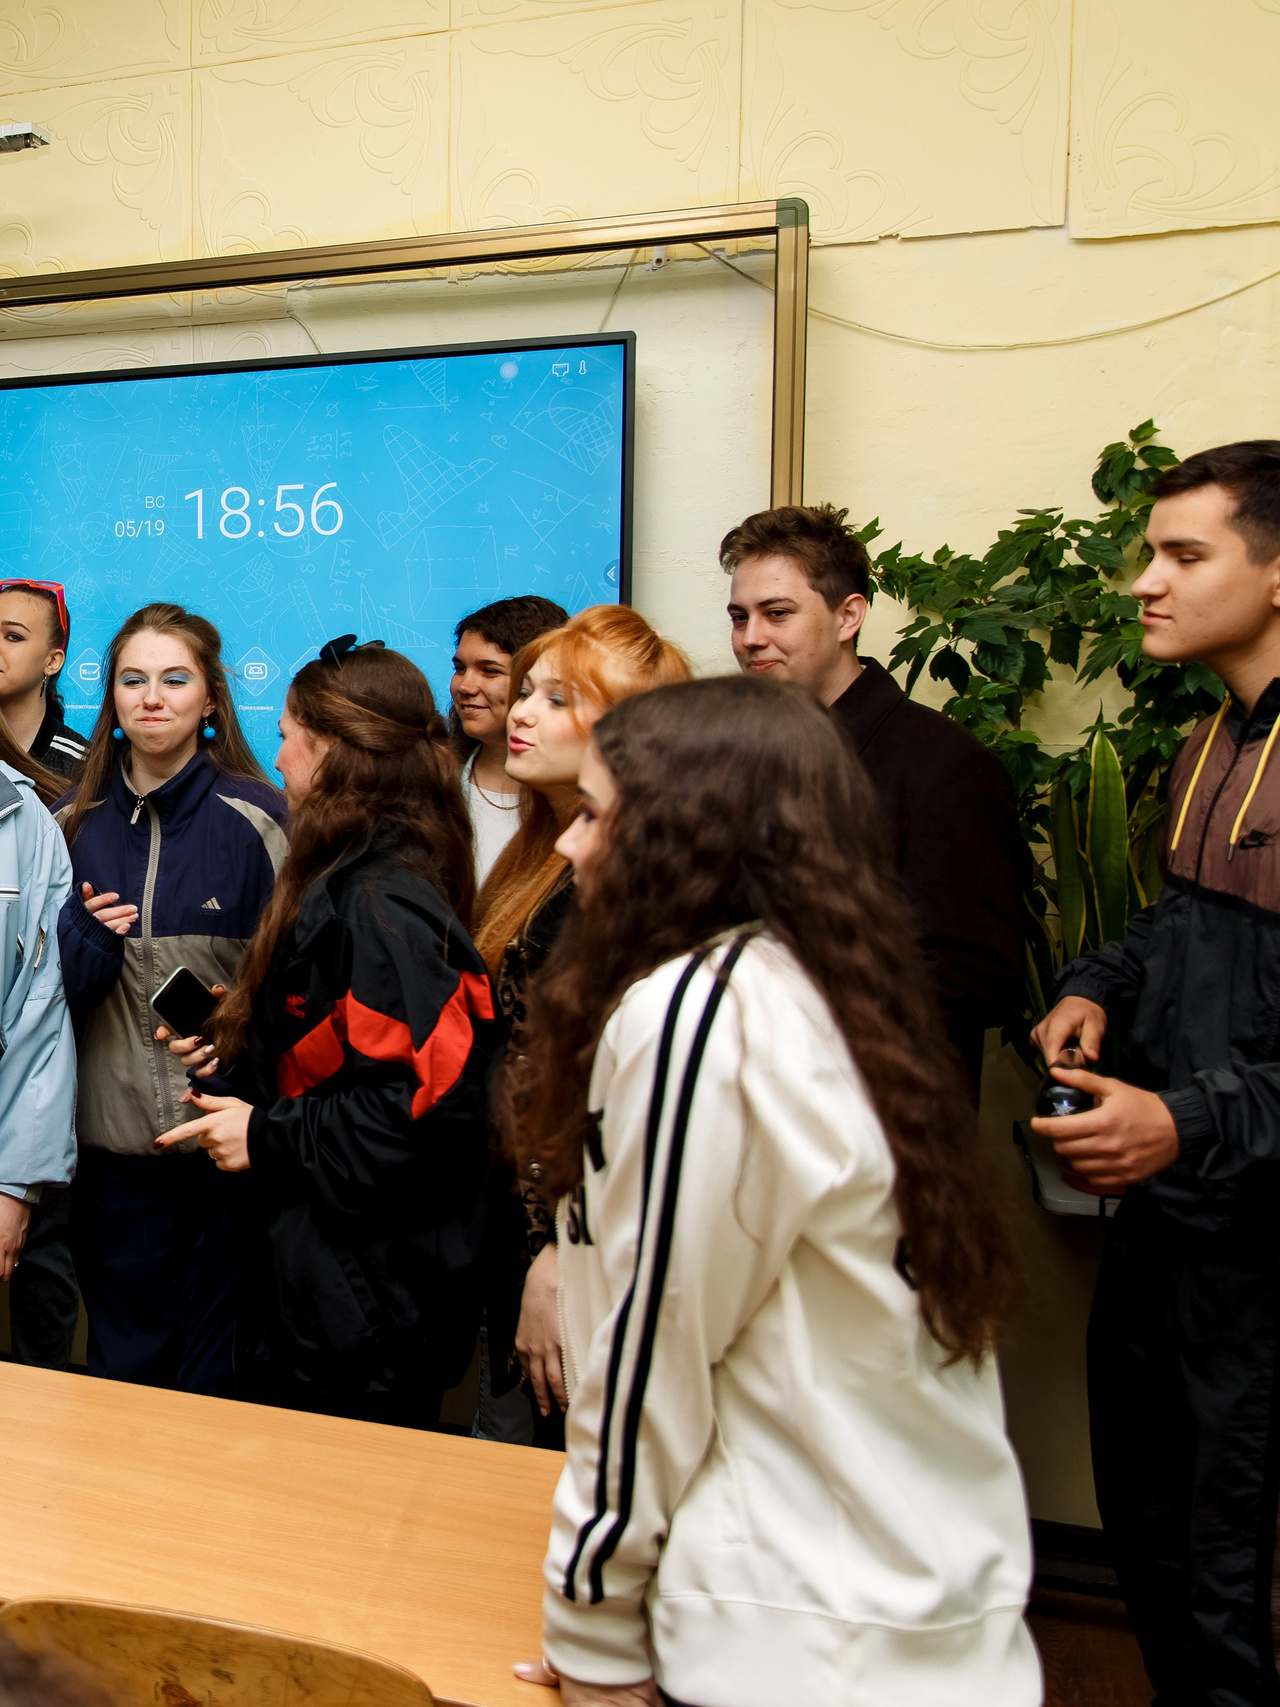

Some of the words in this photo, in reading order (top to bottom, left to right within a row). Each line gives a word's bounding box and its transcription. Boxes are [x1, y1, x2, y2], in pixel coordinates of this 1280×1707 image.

[144, 495, 166, 509] ВС
[184, 482, 344, 540] 18:56
[114, 519, 165, 538] 05/19
